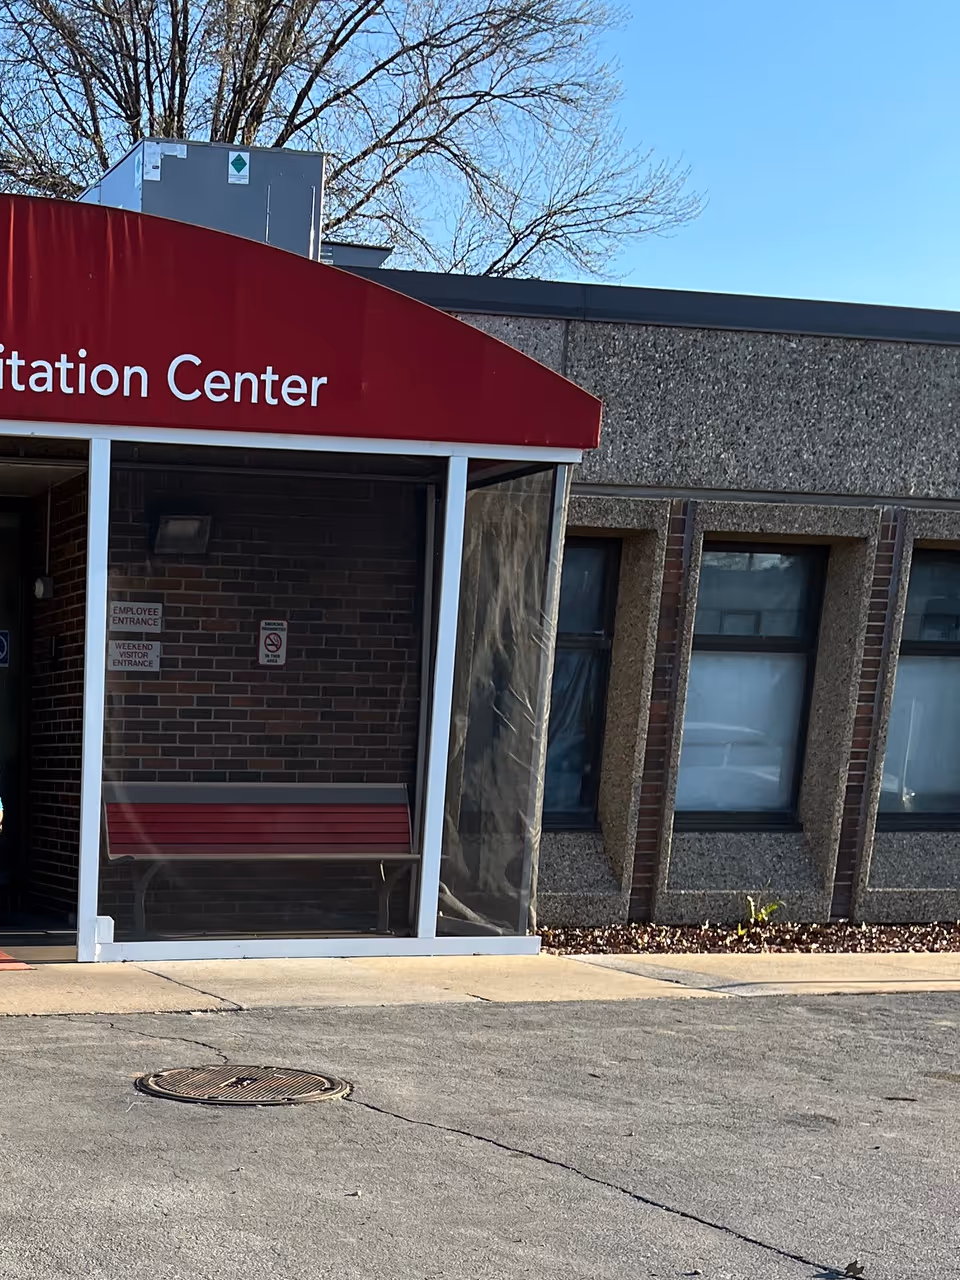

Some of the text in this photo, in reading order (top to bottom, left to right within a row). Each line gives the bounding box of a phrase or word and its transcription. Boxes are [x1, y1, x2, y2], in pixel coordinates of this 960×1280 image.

[167, 353, 328, 407] Center
[113, 606, 159, 616] EMPLOYEE
[112, 616, 159, 627] ENTRANCE
[115, 642, 153, 651] WEEKEND
[119, 651, 148, 659] VISITOR
[112, 659, 153, 668] ENTRANCE
